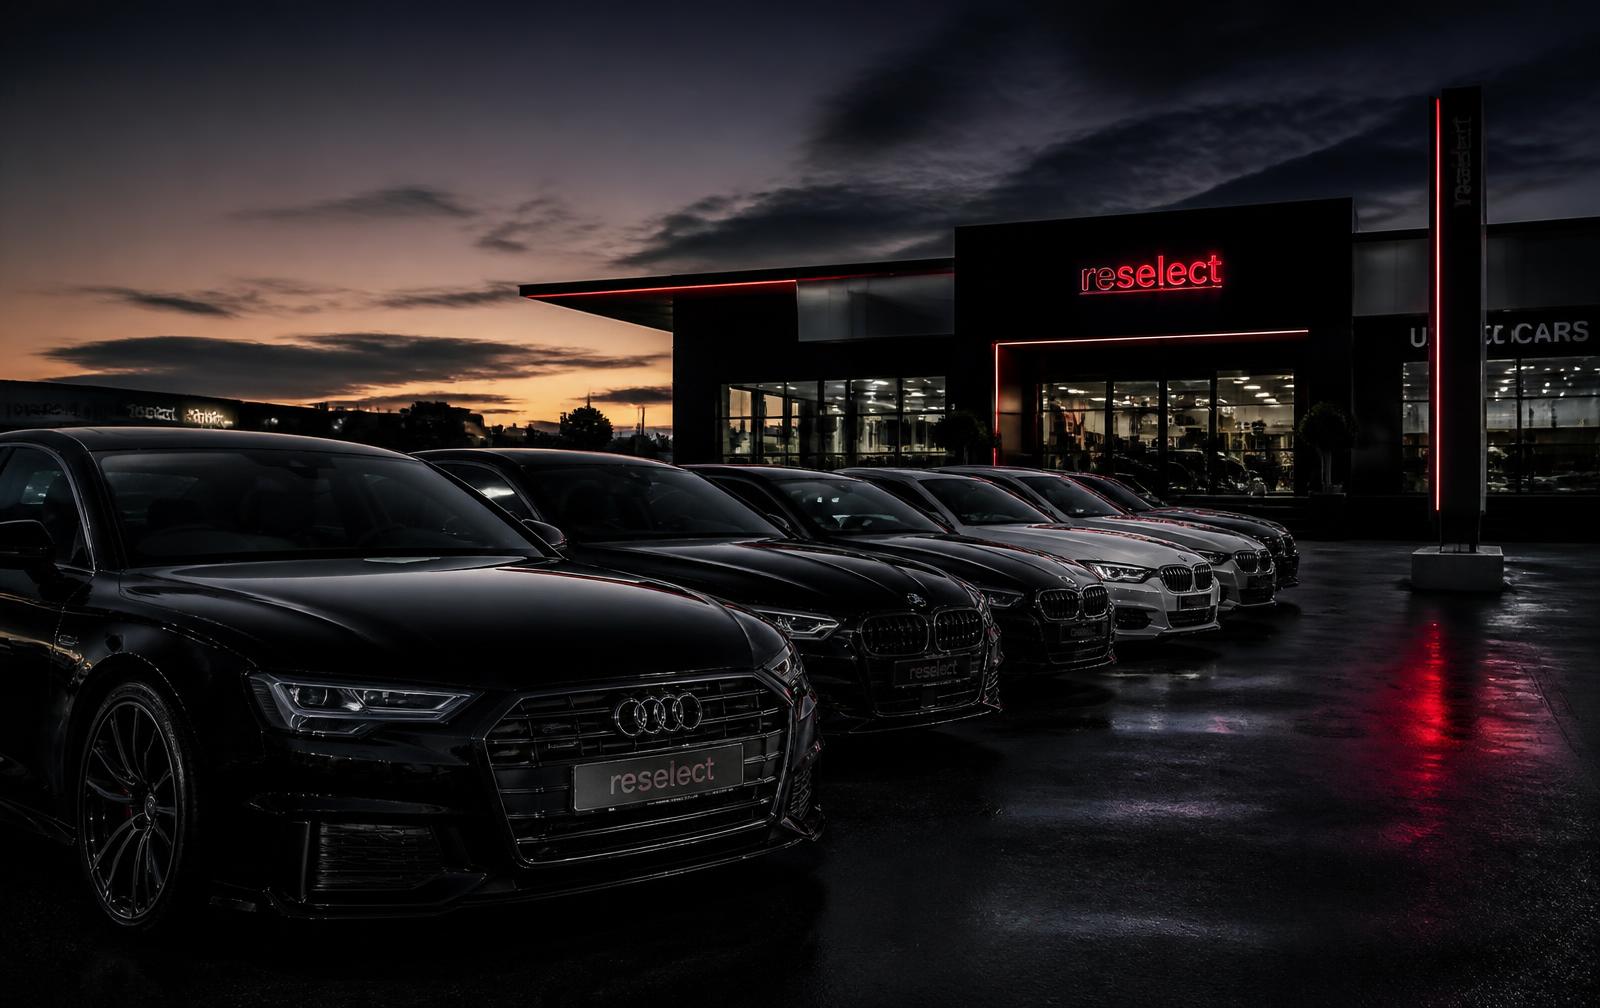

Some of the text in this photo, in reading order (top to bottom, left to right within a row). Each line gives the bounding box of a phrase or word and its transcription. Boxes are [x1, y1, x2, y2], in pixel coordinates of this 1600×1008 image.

[1081, 254, 1222, 292] reselect
[1513, 320, 1590, 345] CARS
[610, 757, 715, 795] reselect
